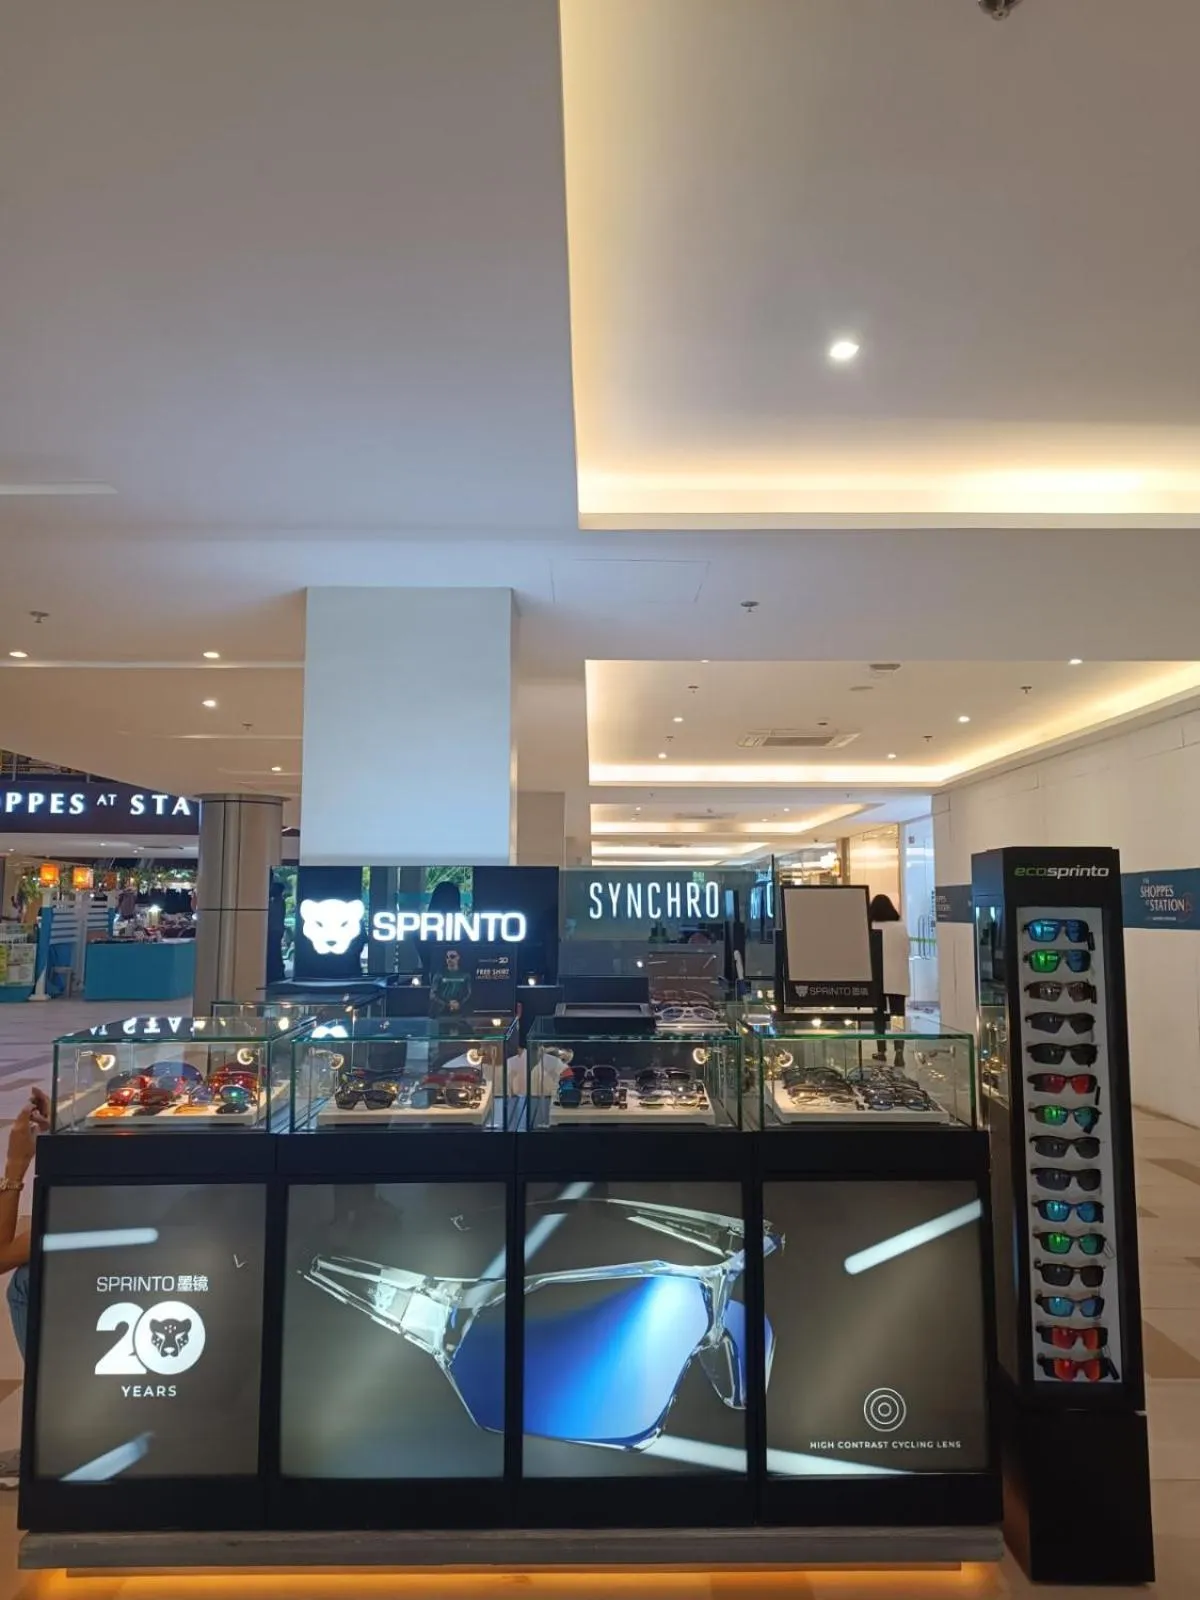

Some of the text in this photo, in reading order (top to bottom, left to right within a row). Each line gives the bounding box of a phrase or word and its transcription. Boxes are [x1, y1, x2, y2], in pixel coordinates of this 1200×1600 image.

[0, 792, 85, 815] PPES
[97, 794, 117, 806] AT
[1014, 865, 1110, 879] ecosprinto
[589, 881, 720, 919] SYNCHRO
[1150, 899, 1185, 912] STATION
[372, 911, 527, 942] SPRINTO
[809, 986, 851, 996] SPRINTO
[96, 1275, 209, 1292] SPRINTO 墨镜
[94, 1301, 206, 1375] 20
[121, 1385, 177, 1397] YEARS
[810, 1441, 961, 1449] HIGH CONTRAST CYCLING LENS
